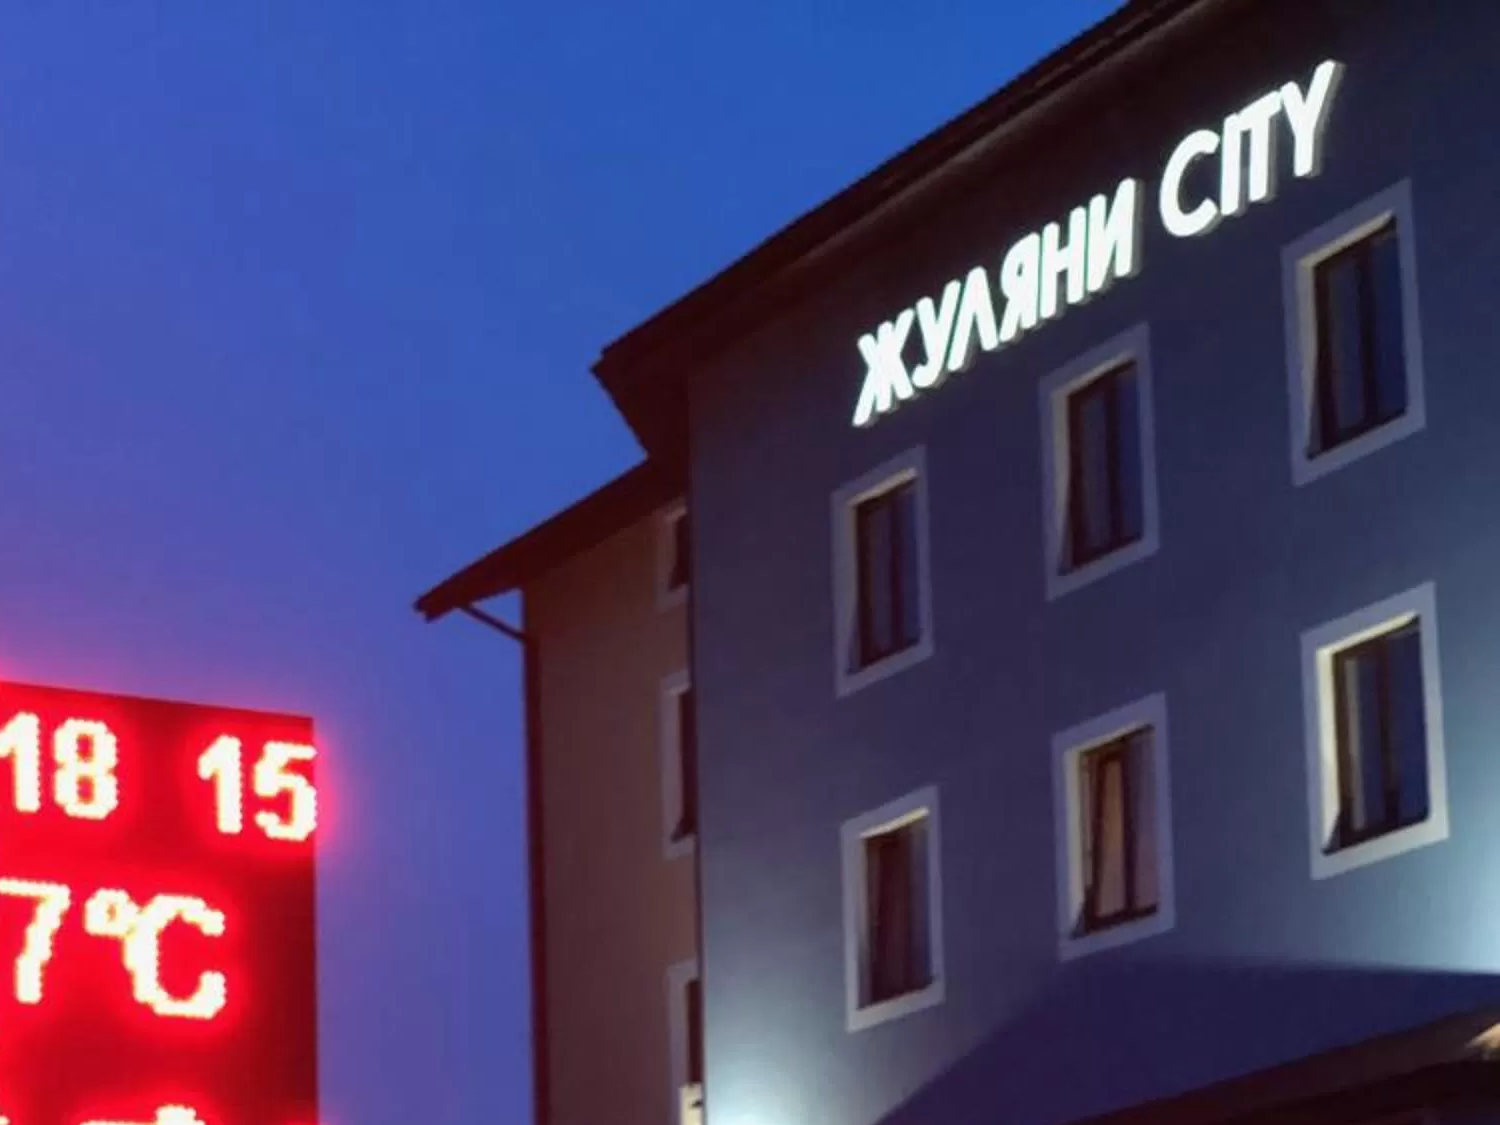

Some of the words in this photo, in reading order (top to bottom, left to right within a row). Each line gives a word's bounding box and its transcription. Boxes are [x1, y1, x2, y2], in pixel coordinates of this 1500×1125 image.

[852, 177, 1139, 427] ЖУЛЯНИ
[1159, 59, 1340, 237] CITY
[198, 735, 317, 840] 15
